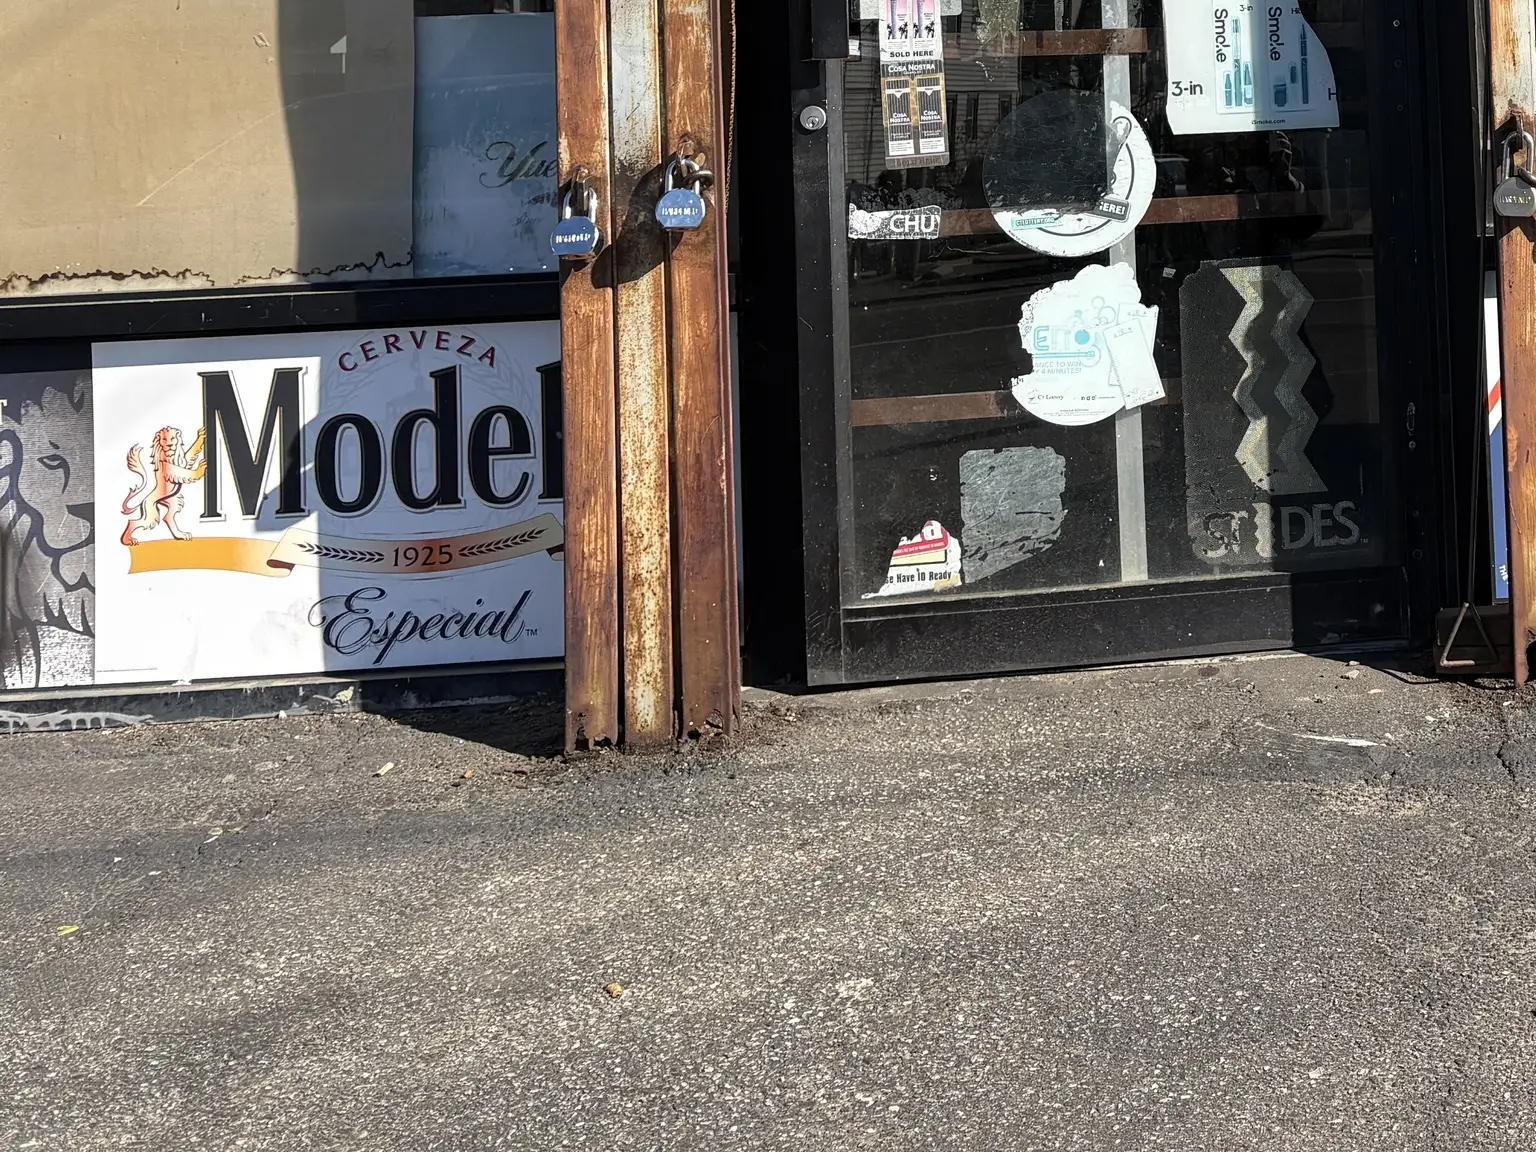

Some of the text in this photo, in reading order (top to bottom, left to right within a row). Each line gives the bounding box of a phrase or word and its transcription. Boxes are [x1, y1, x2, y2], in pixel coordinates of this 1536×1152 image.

[908, 63, 936, 71] NOSTRA
[1171, 80, 1203, 97] 3-in
[338, 329, 498, 372] CERVEZA
[198, 363, 563, 523] Model
[393, 543, 454, 567] 1925
[896, 573, 915, 583] Have
[928, 570, 952, 581] Ready
[308, 585, 527, 665] Especial
